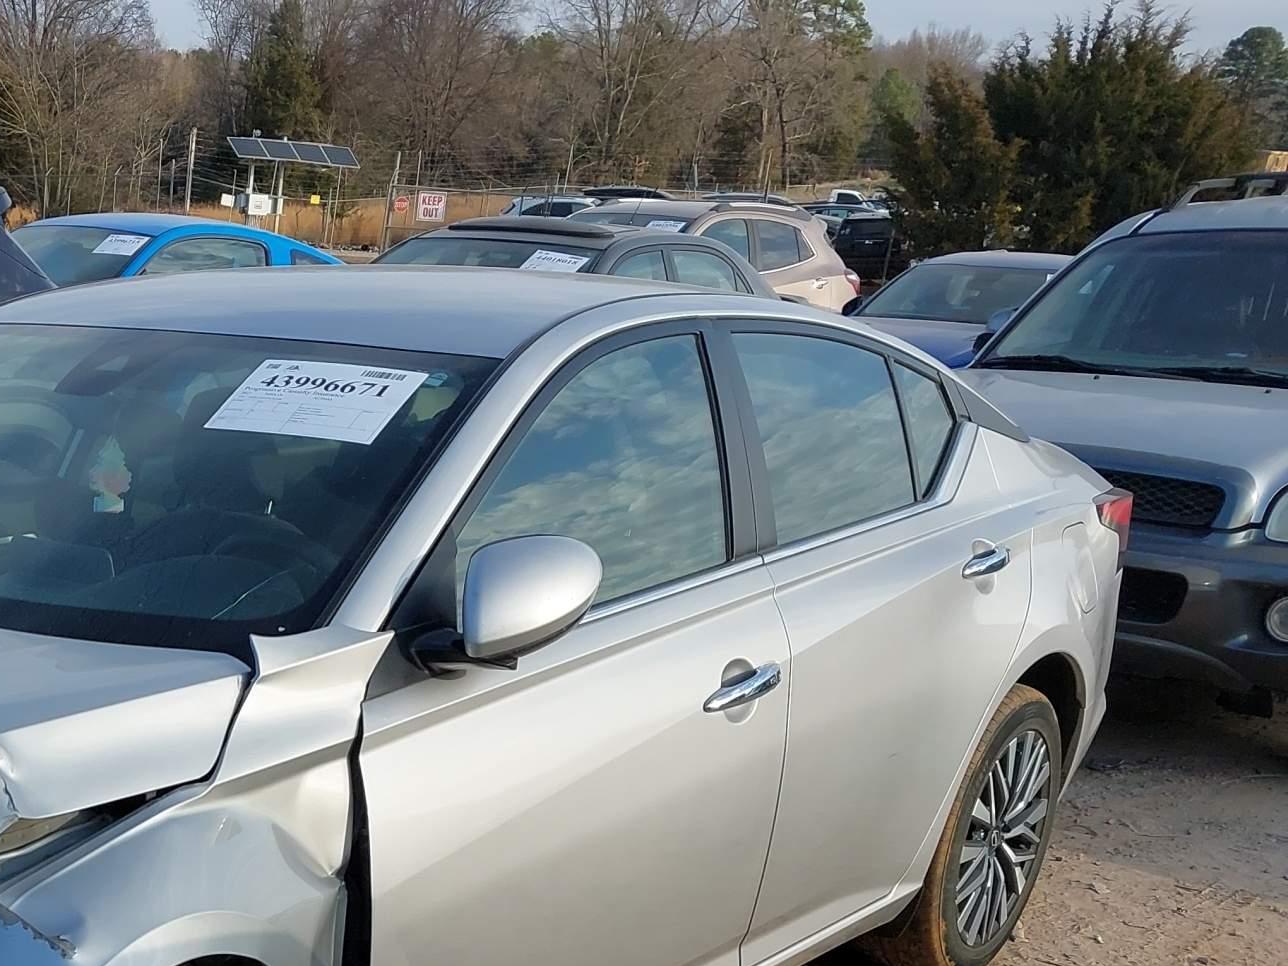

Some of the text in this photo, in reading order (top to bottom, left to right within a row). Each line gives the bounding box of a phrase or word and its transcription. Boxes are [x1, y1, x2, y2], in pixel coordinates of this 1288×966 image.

[422, 195, 443, 206] KEEP
[422, 207, 440, 218] OUT
[261, 374, 391, 398] 43996671
